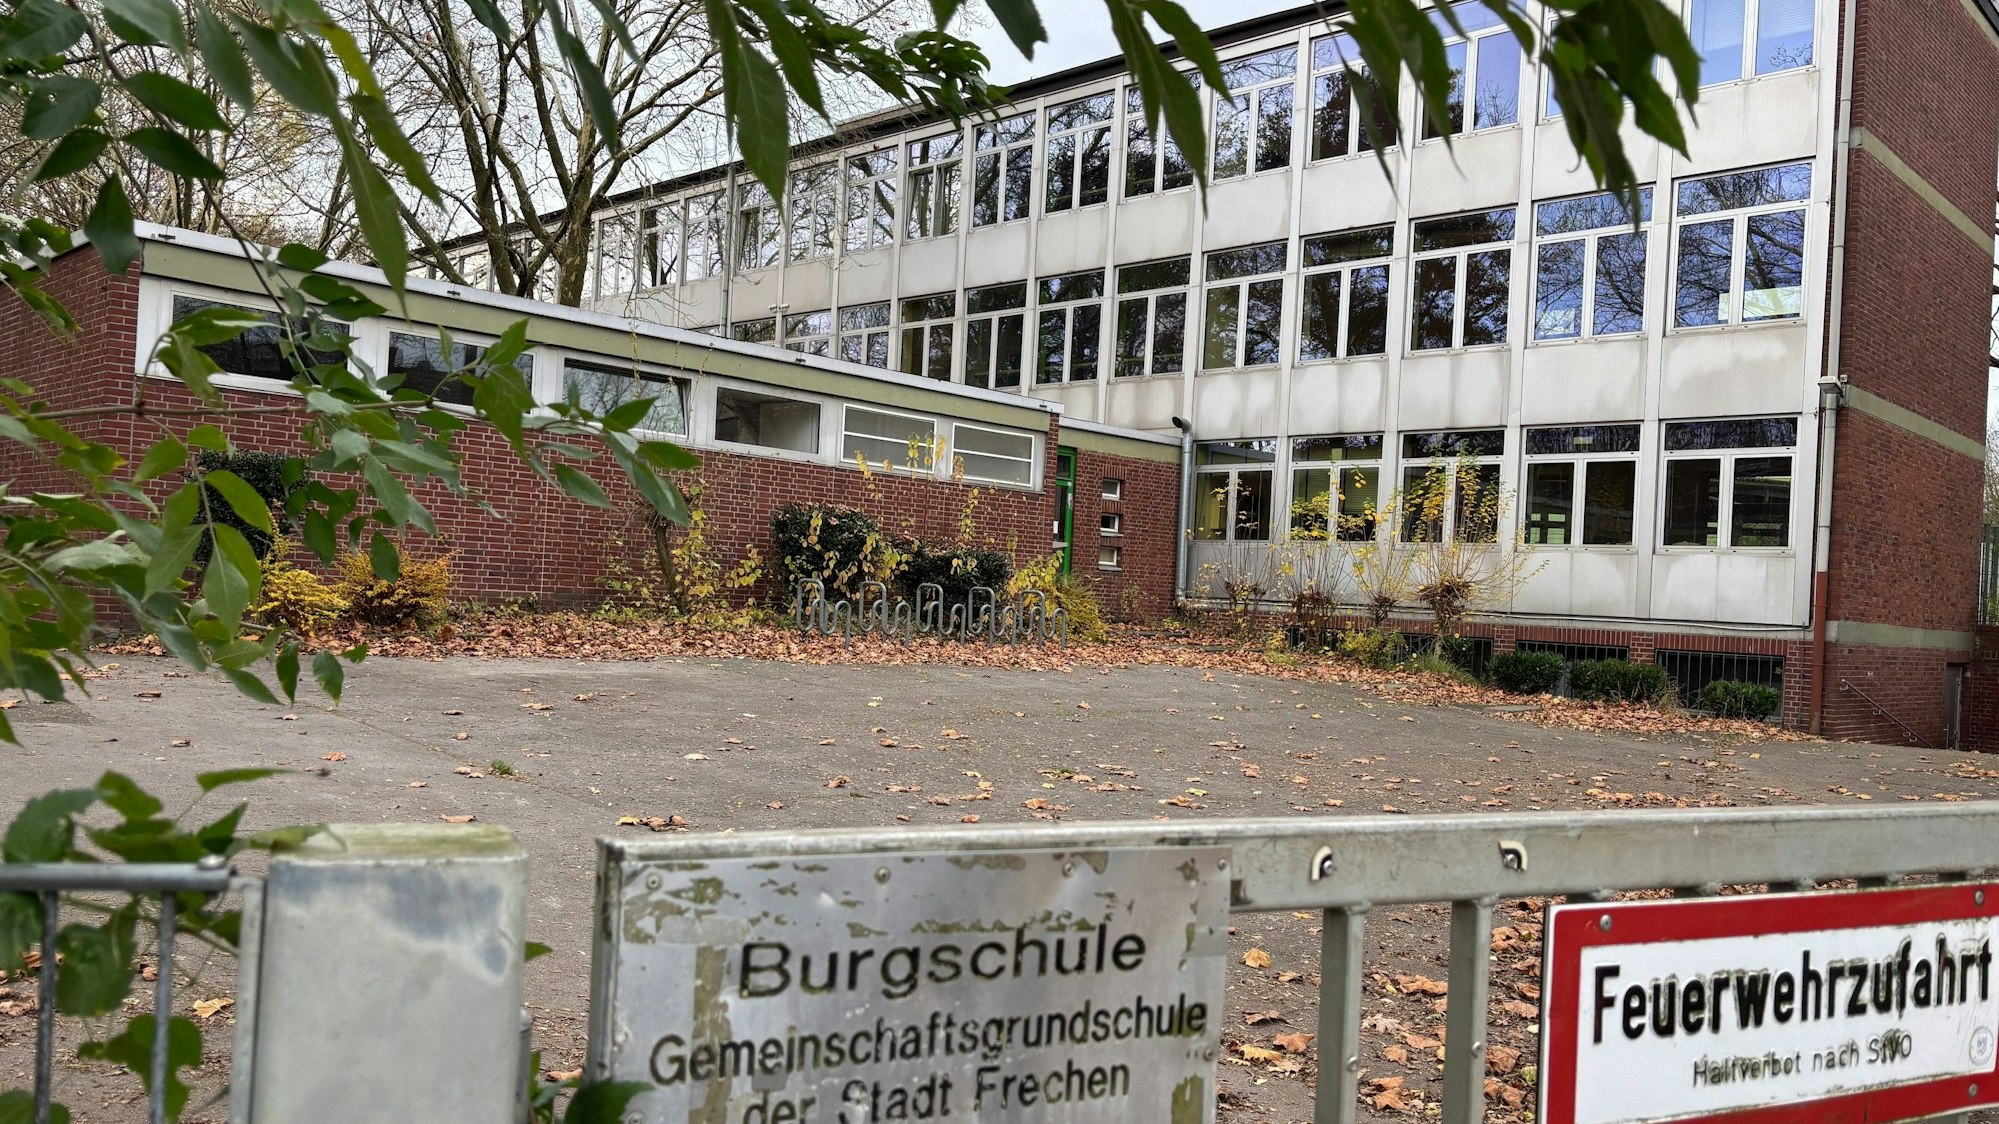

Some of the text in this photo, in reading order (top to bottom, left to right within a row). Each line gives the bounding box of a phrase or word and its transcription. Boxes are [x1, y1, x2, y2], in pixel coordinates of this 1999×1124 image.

[738, 924, 1146, 999] Burgschule
[1593, 934, 1994, 1044] Feuerwehrzufahrt
[649, 993, 1208, 1086] Gemeinschaftsgrundschule
[1813, 1041, 1860, 1072] nach
[742, 1059, 1131, 1124] der Stadt Frechen
